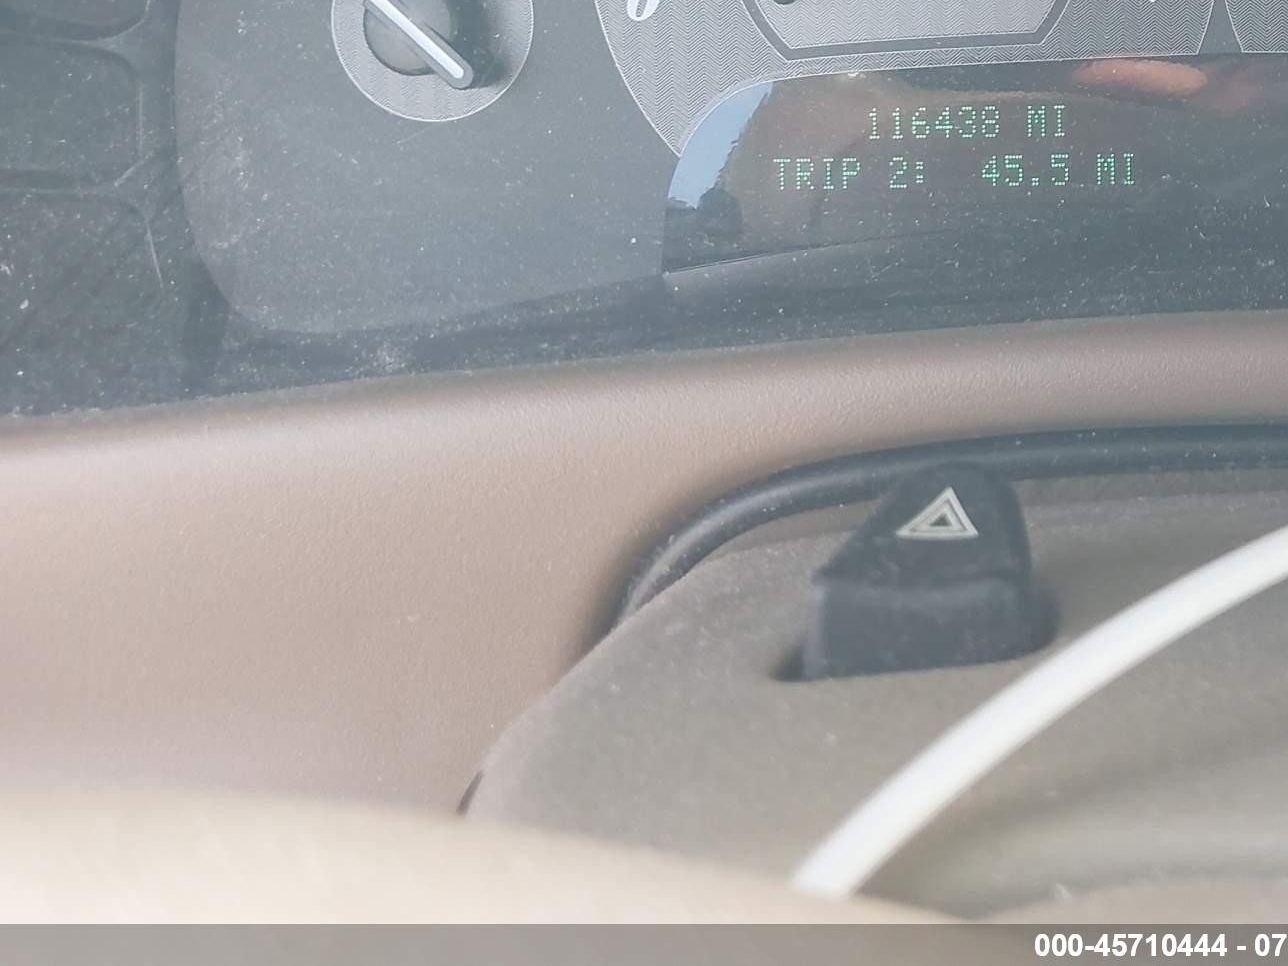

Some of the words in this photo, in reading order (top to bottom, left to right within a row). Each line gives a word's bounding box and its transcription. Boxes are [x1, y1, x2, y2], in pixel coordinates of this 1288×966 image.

[868, 106, 1000, 140] 116438
[1027, 104, 1066, 138] MI
[773, 157, 861, 191] TRIP
[888, 156, 925, 190] 2:
[981, 153, 1070, 187] 45.5
[1096, 153, 1135, 187] MI
